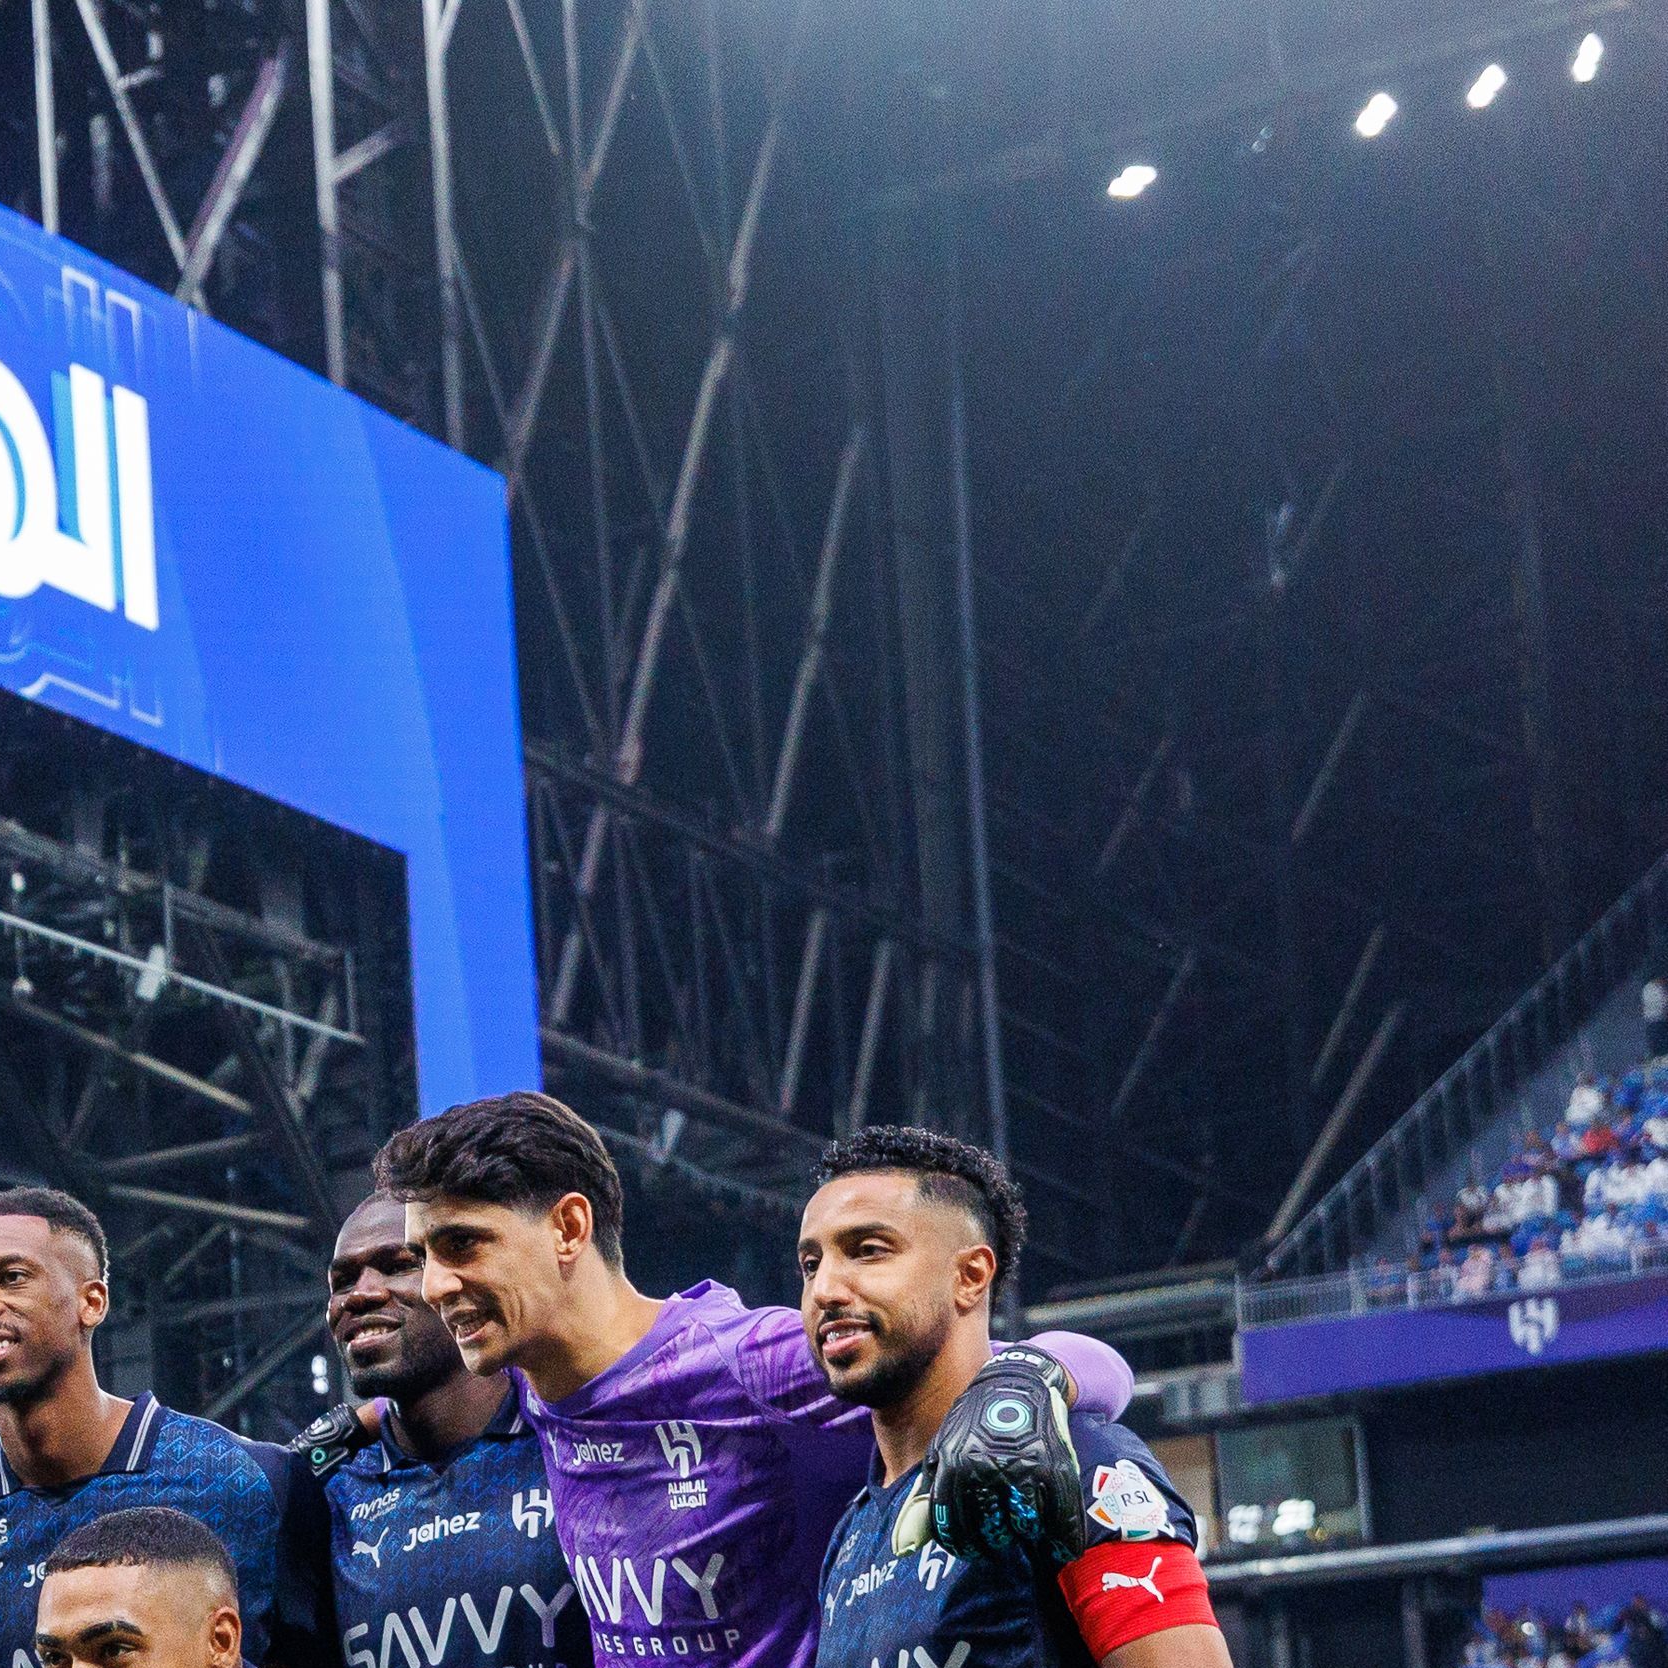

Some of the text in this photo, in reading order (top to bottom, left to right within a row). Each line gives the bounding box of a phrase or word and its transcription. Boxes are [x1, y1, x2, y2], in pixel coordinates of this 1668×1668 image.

[573, 1438, 624, 1466] jahez
[668, 1479, 708, 1495] ALHILAL
[351, 1487, 400, 1521] flynas
[403, 1510, 481, 1552] jahez
[564, 1552, 725, 1627] AVVY
[632, 1629, 741, 1656] GROUP
